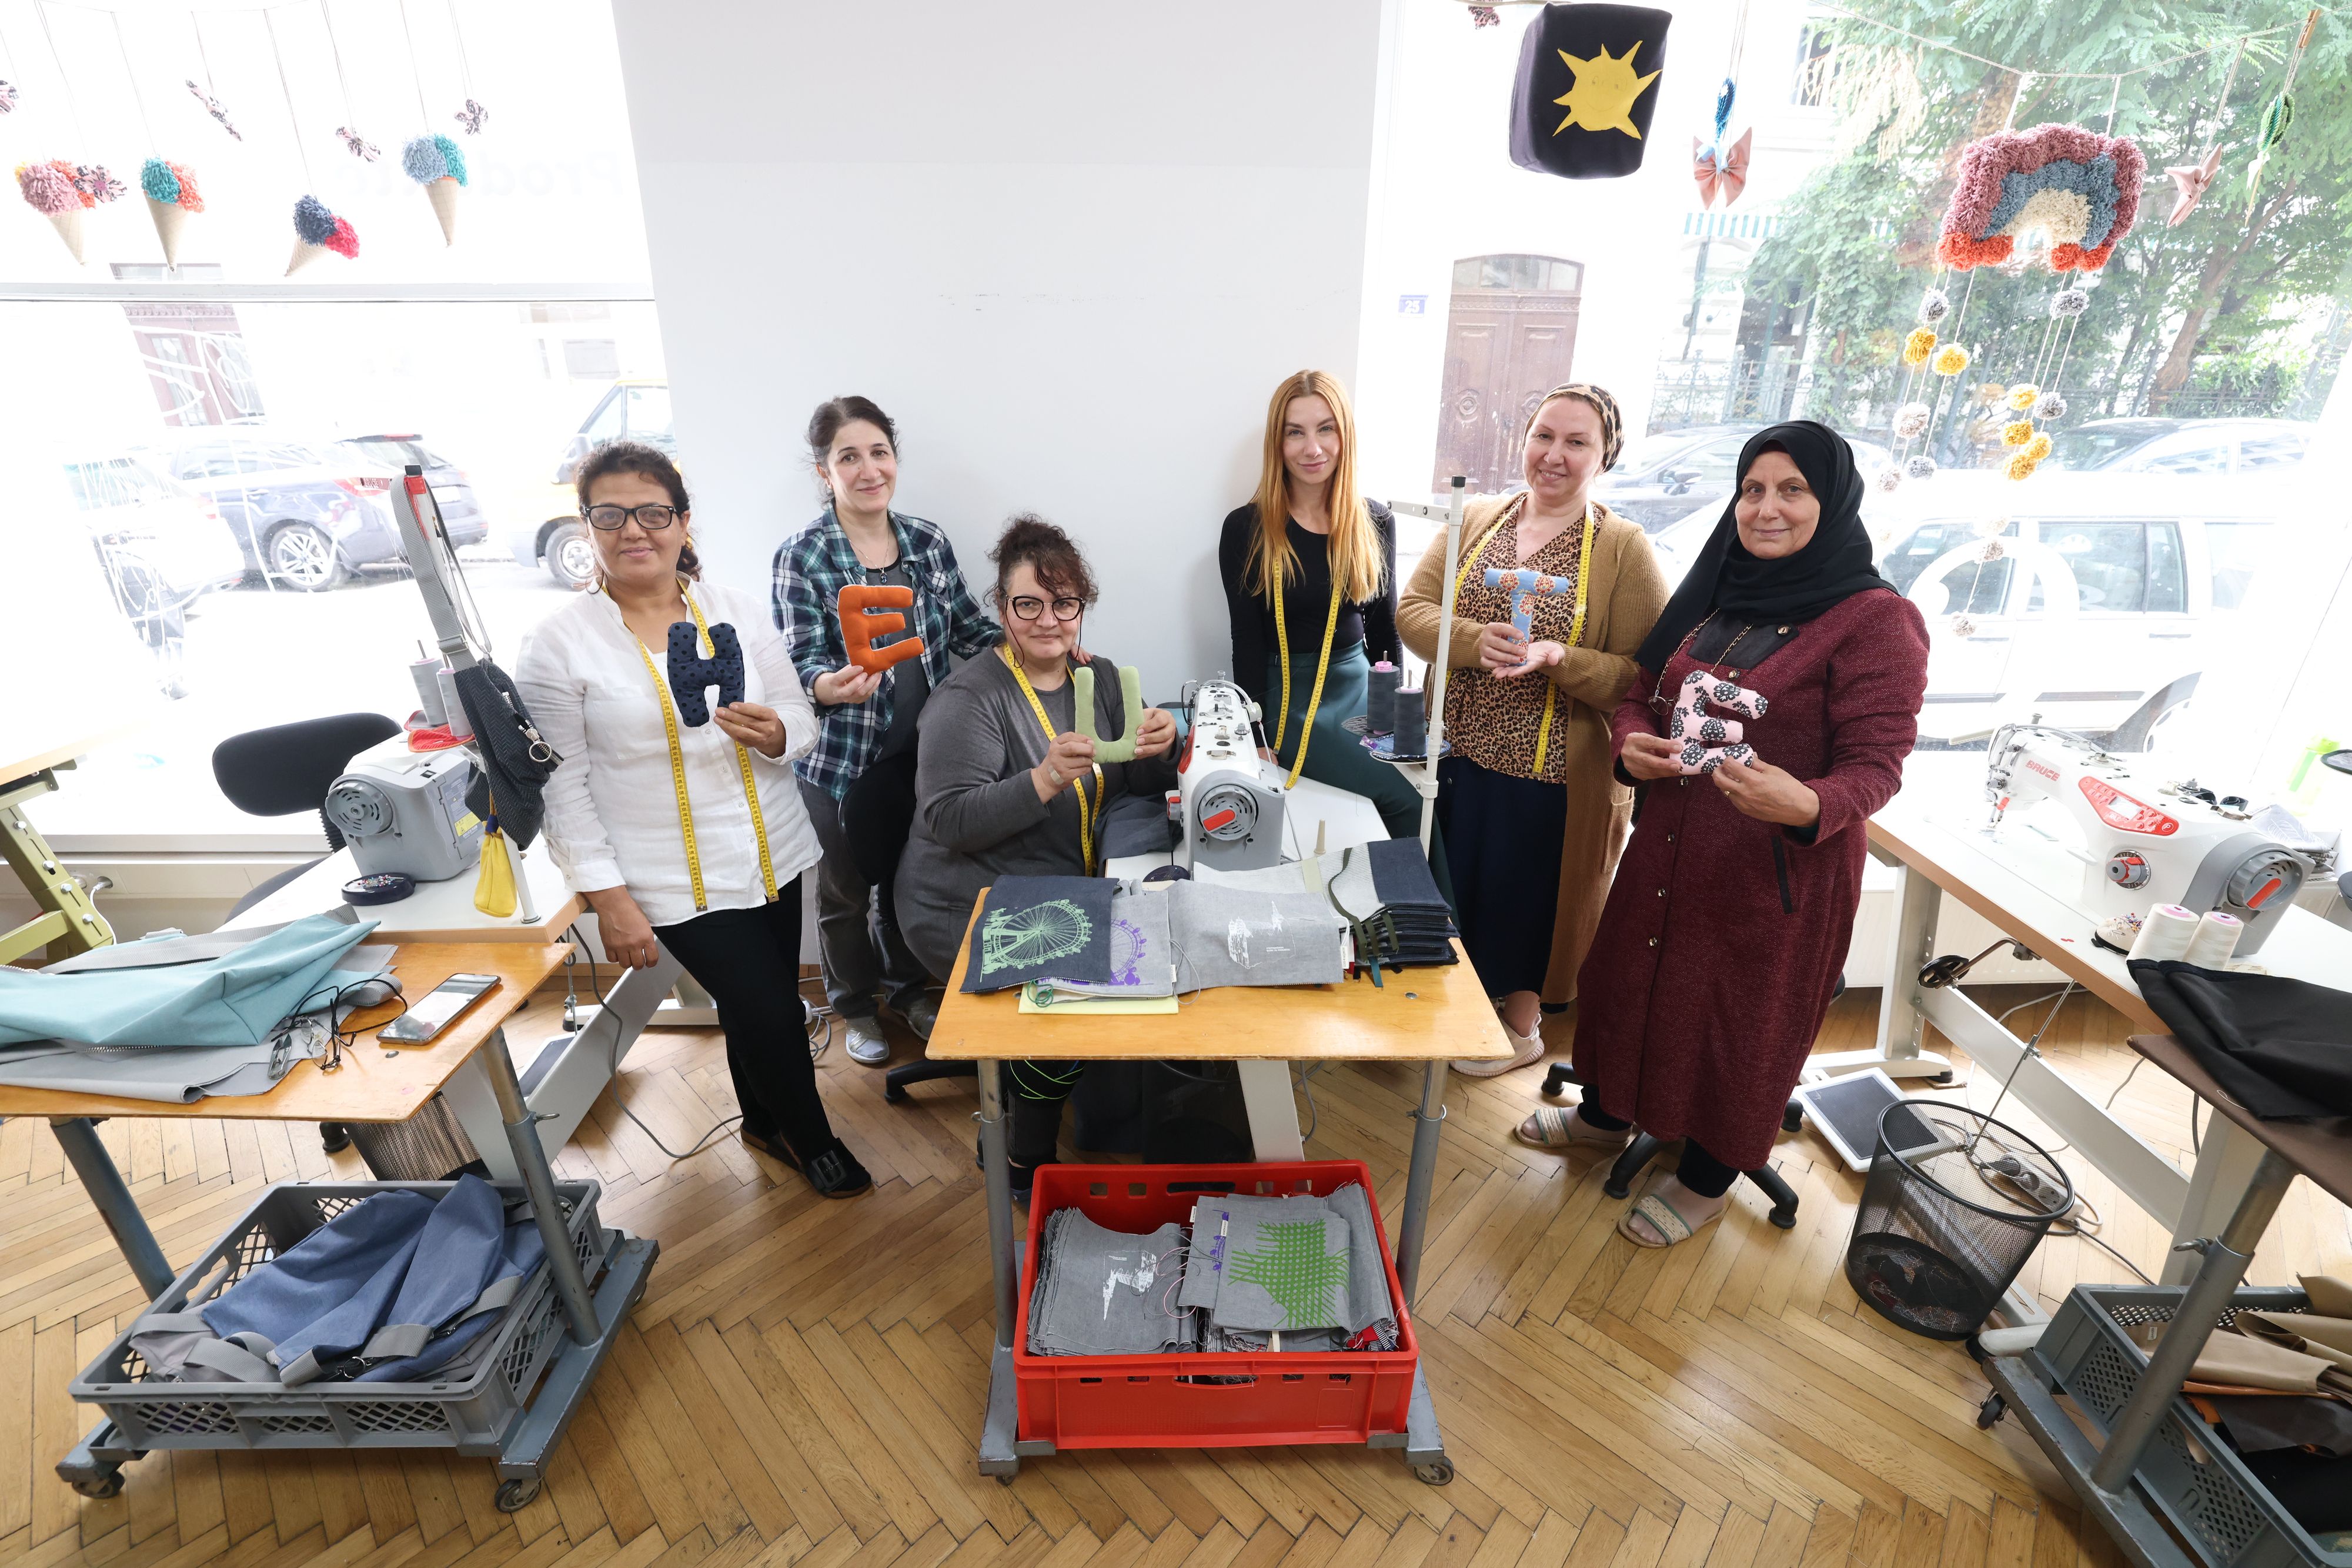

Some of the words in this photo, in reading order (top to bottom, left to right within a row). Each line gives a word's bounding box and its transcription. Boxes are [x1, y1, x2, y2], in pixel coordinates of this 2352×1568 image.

[1405, 299, 1421, 313] 25
[837, 585, 924, 677] E
[1485, 568, 1569, 666] T
[667, 622, 744, 727] H
[1074, 666, 1145, 764] U
[1669, 670, 1769, 775] E
[2026, 760, 2060, 781] BRUCE
